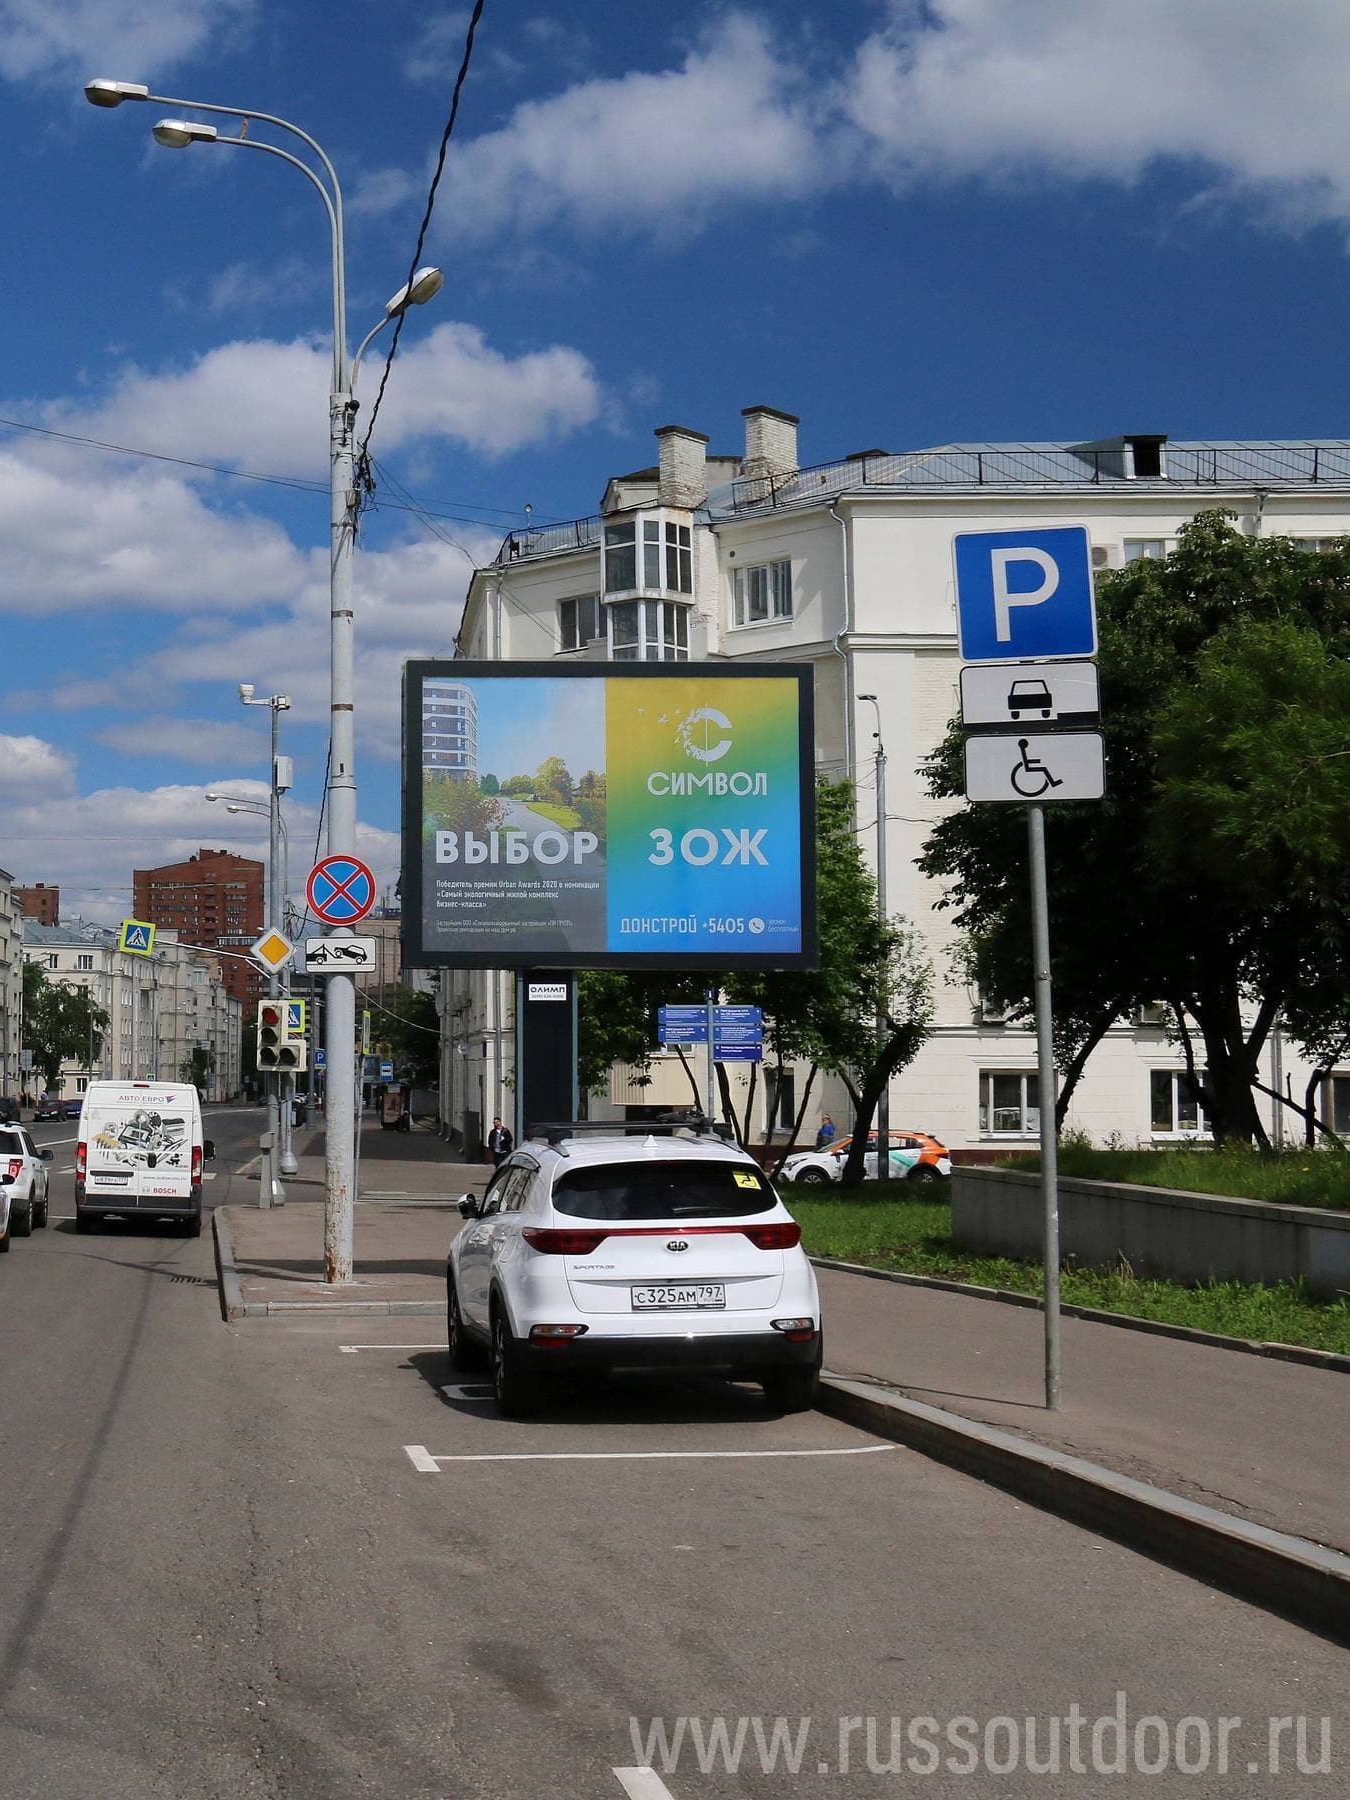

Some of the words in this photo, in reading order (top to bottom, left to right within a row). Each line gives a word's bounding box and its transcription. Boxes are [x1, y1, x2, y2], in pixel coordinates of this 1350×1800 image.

[991, 547, 1060, 642] P
[647, 771, 768, 796] СИМВОЛ
[435, 830, 599, 865] ВЫБОР
[648, 828, 769, 866] ЗОЖ
[436, 880, 473, 889] Победитель
[498, 880, 517, 889] Urban
[518, 880, 541, 889] Awards
[542, 880, 558, 889] 2020
[564, 882, 600, 890] номинации
[436, 889, 463, 898] «Самый
[464, 890, 505, 899] экологичный
[506, 890, 527, 899] жилой
[619, 914, 697, 934] ДОНСТРОЙ
[153, 1187, 177, 1195] BOSCH
[669, 1240, 687, 1250] KIA
[698, 1285, 721, 1299] 797
